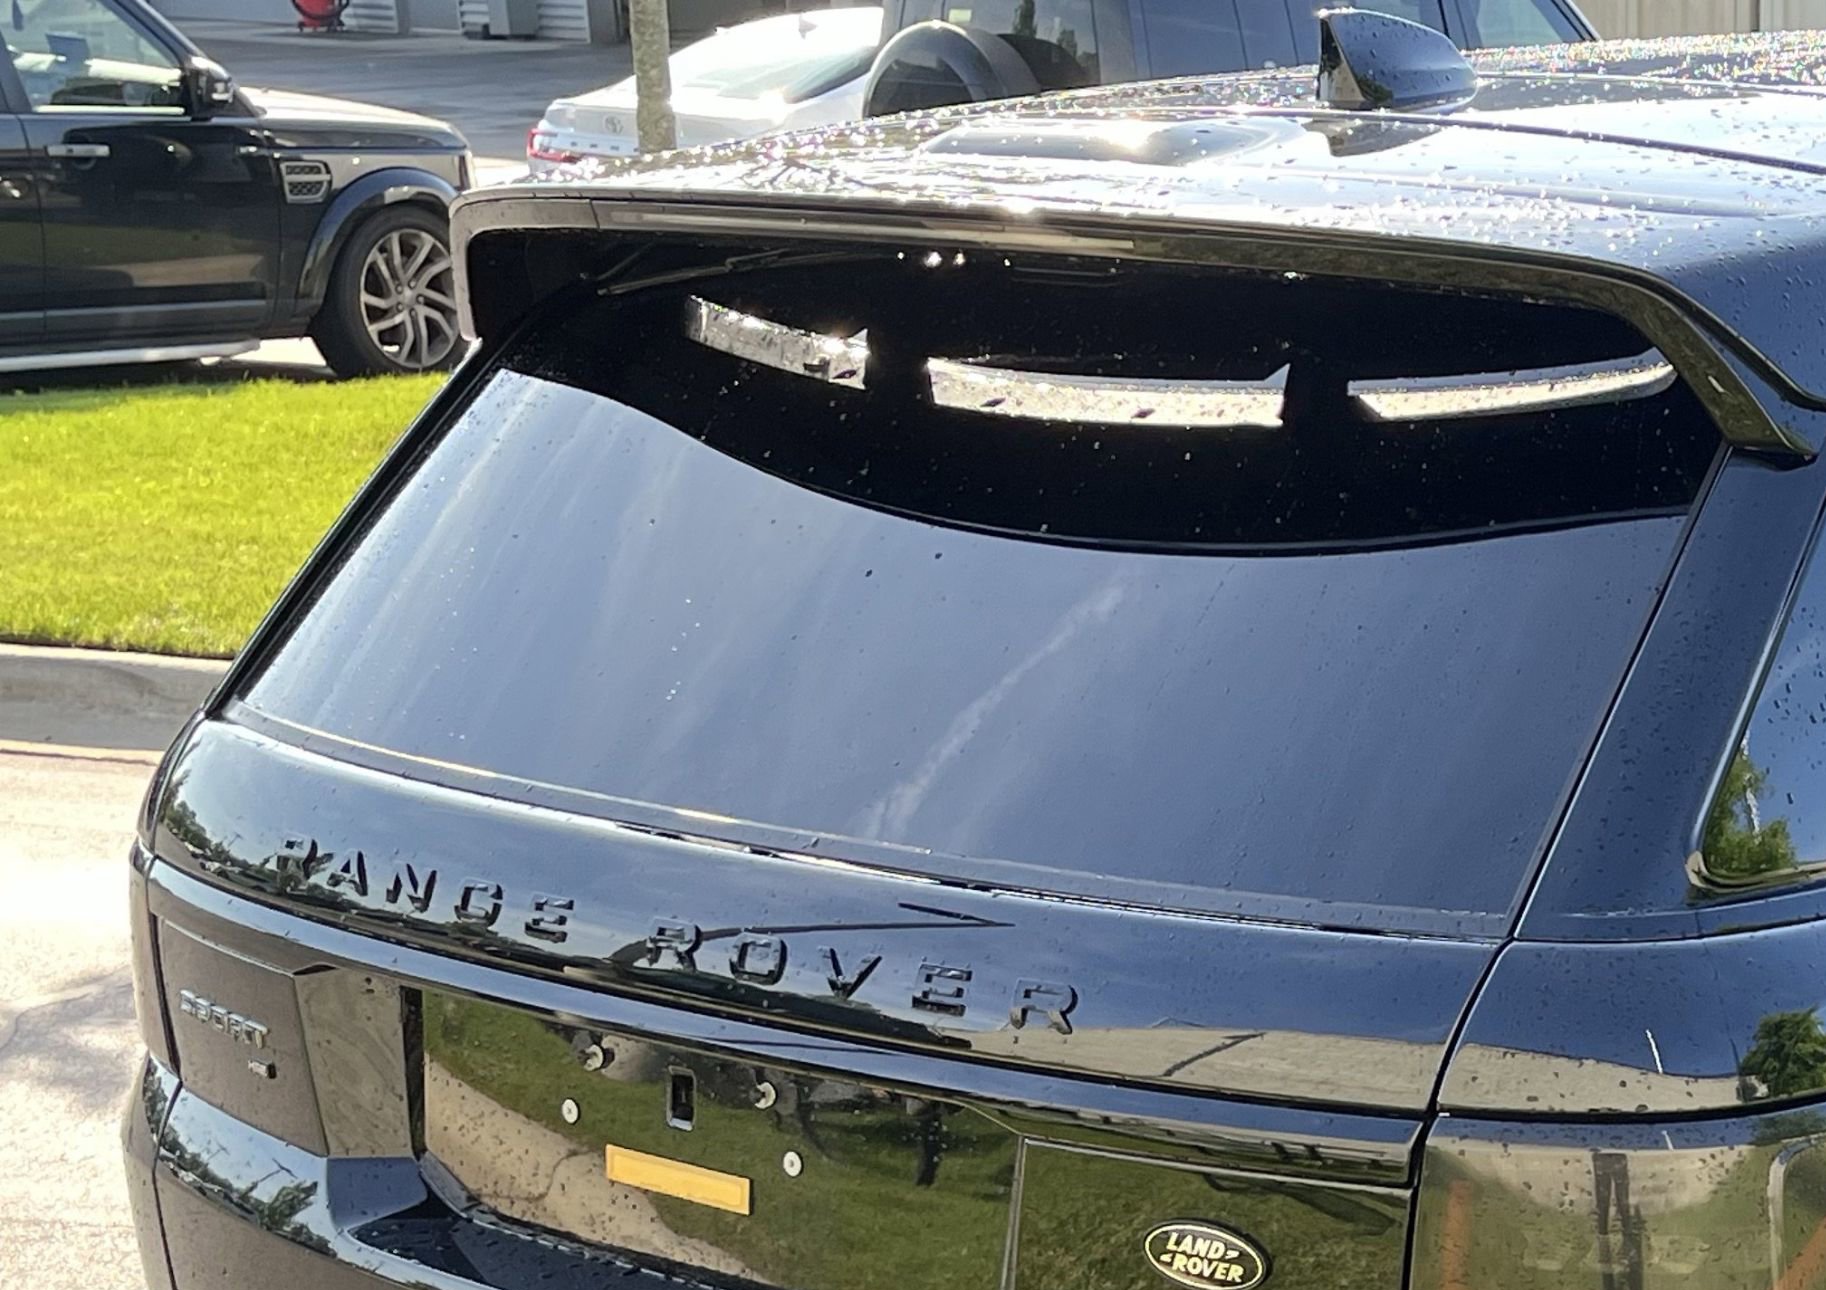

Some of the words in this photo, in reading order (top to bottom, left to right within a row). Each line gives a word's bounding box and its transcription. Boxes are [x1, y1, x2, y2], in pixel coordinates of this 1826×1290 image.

[276, 833, 577, 944] RANGE
[645, 897, 1079, 1035] ROVER
[1166, 1232, 1226, 1260] LAND
[1172, 1252, 1245, 1283] ROVER
